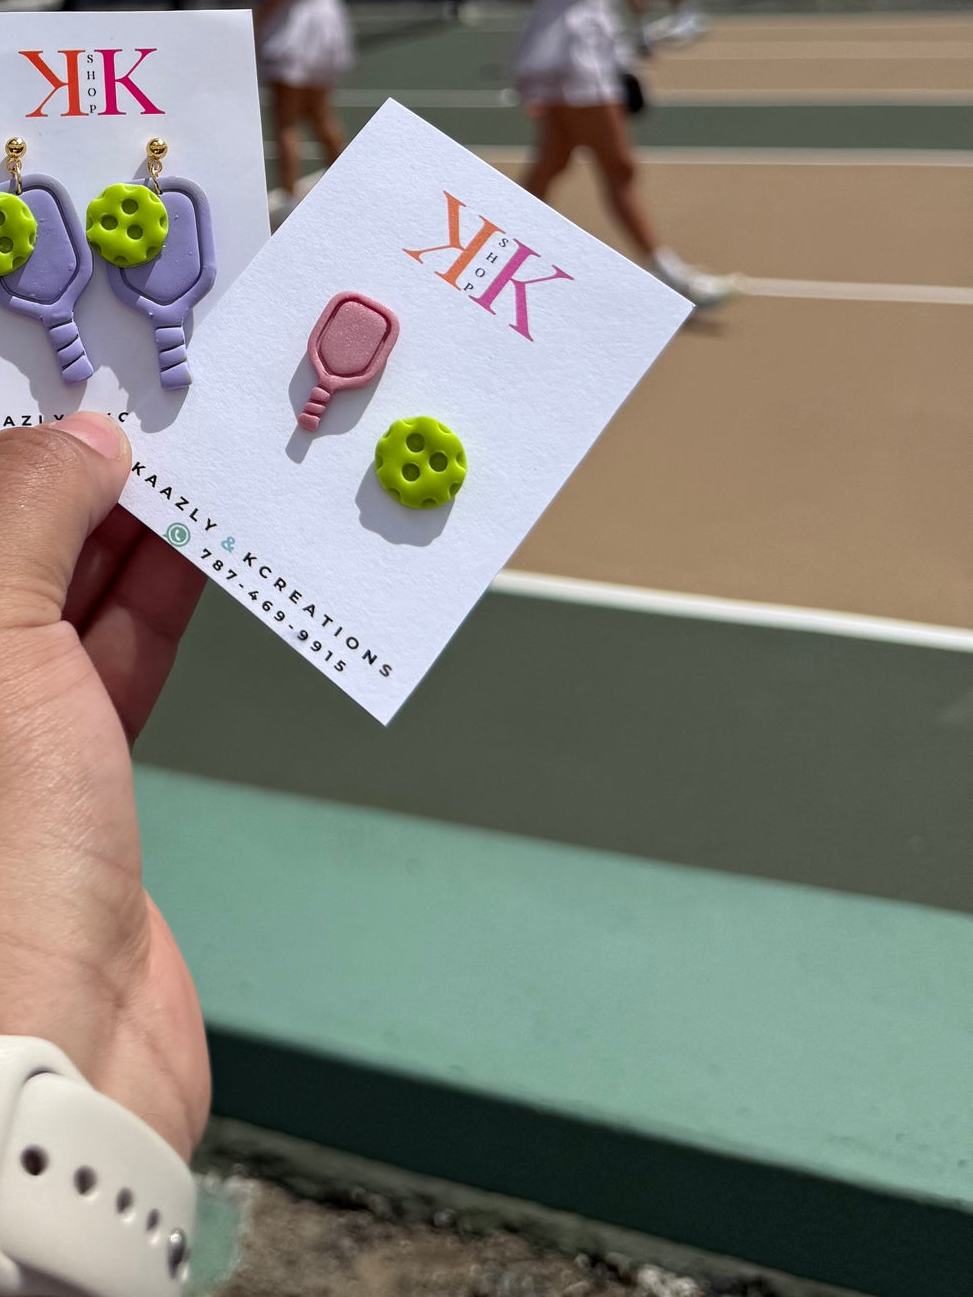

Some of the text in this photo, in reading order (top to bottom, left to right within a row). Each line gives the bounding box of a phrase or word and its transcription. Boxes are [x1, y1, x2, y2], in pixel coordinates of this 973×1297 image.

[86, 54, 98, 114] SHOP
[463, 238, 509, 292] SHOP
[131, 461, 393, 678] KAAZLY & KCREATIONS
[200, 548, 346, 673] 787-469-9915
